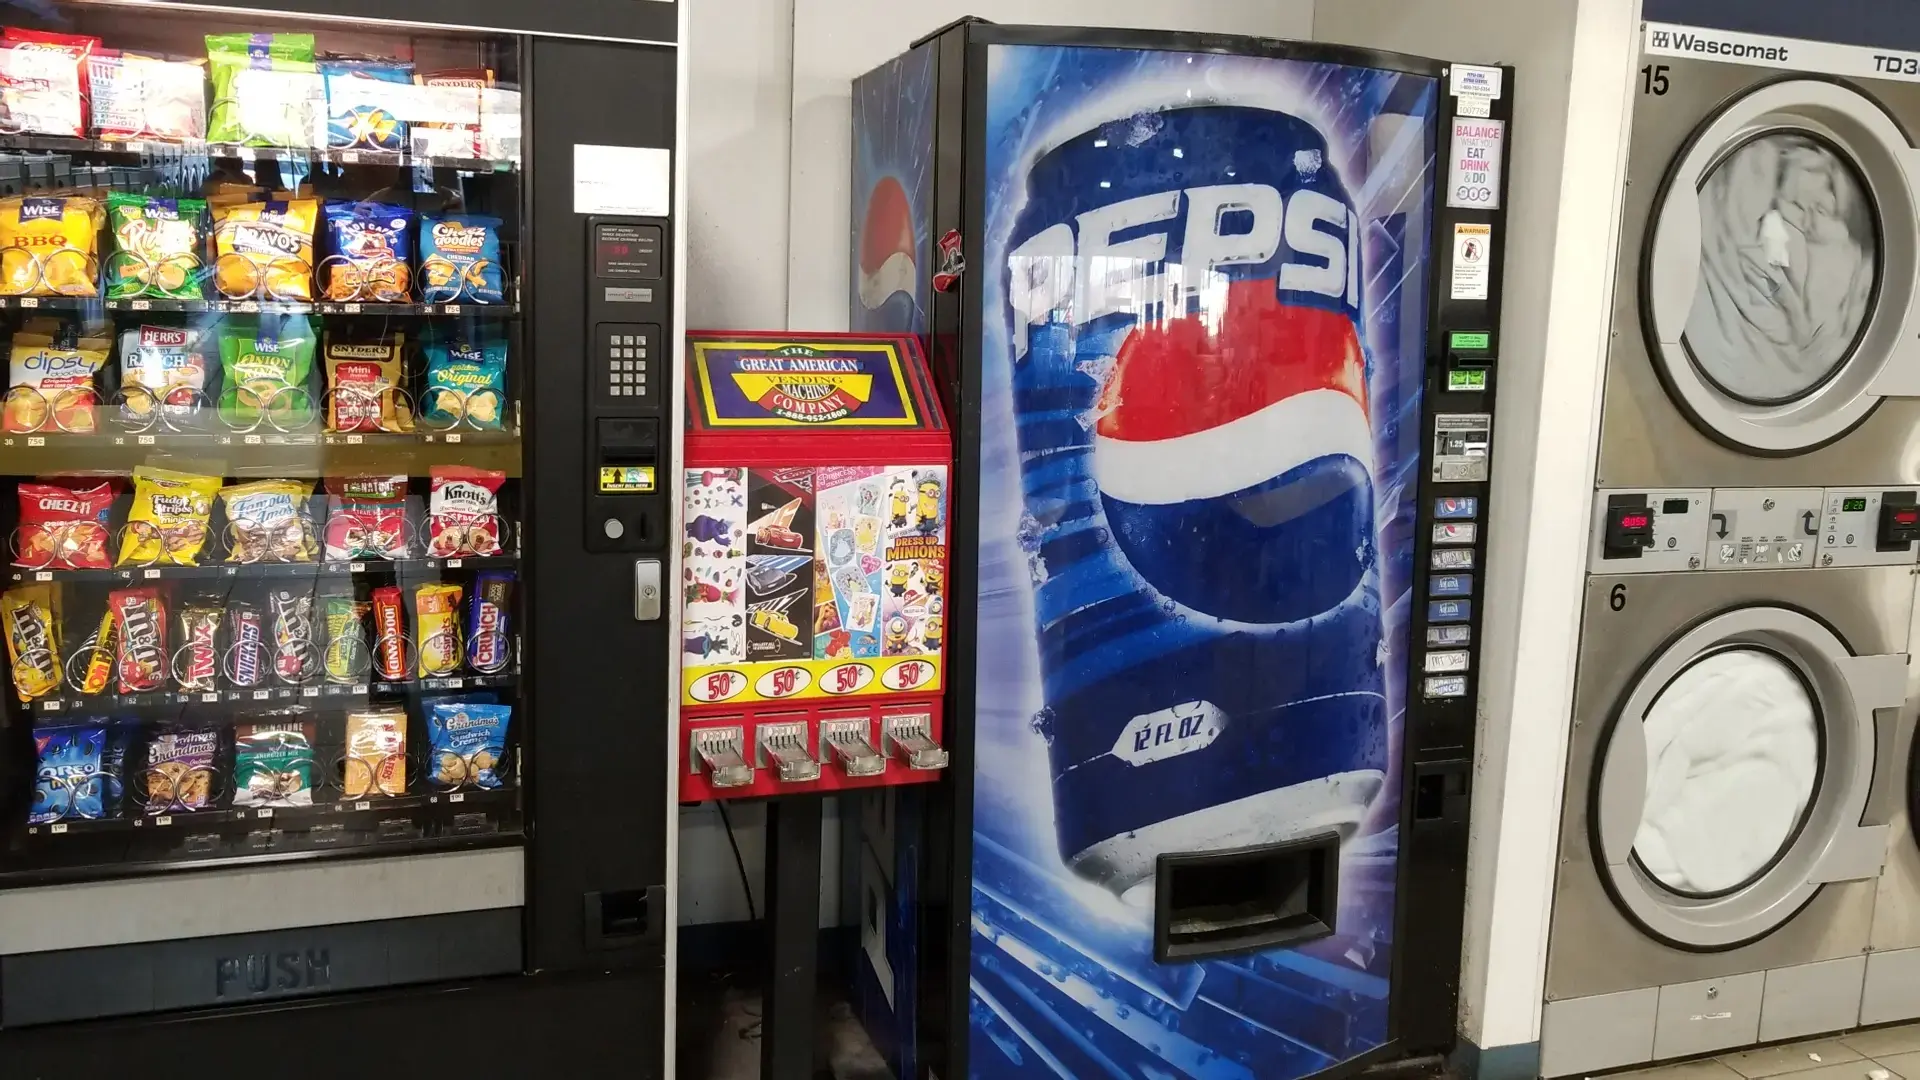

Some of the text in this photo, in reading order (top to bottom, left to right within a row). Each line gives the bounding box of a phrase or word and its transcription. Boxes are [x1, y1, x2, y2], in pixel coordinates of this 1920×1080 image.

[1672, 32, 1920, 74] Wascomat TD3
[1641, 63, 1670, 96] 15
[1456, 125, 1500, 139] BALANCE
[1461, 138, 1492, 147] WHAT YOU
[1467, 148, 1485, 158] EAT
[1460, 160, 1490, 171] DRINK
[1464, 172, 1486, 184] & DO
[23, 205, 59, 217] WISE
[145, 208, 179, 219] WISE
[432, 223, 486, 237] Cheez
[14, 235, 68, 248] BBQ
[434, 234, 485, 248] doodles
[1009, 183, 1360, 364] PEPSI
[22, 299, 37, 307] 75¢
[144, 330, 182, 343] HERR'S
[253, 342, 280, 353] WISE
[334, 344, 388, 354] SNYDER'S
[780, 346, 814, 357] THE
[240, 353, 292, 369] ONION
[450, 349, 483, 361] WISE
[25, 350, 95, 375] dipsy
[740, 358, 858, 372] GREAT AMERICAN
[347, 366, 371, 374] Mini
[437, 370, 492, 386] Original
[766, 376, 844, 384] VENDING
[782, 384, 831, 400] MACHINE
[772, 394, 846, 414] COMPANY
[776, 408, 848, 422] 1-888-952-1800
[28, 438, 44, 446] 75¢
[115, 437, 124, 445] 32
[222, 436, 231, 444] 34
[1450, 440, 1463, 448] 1.25
[152, 494, 190, 507] Fudge
[444, 485, 487, 505] Knott's
[39, 499, 91, 514] CHEEZ-IT
[152, 503, 194, 515] Stripes
[895, 535, 939, 547] DRESS UP
[885, 546, 946, 561] MINIONS
[1609, 583, 1627, 612] 6
[478, 602, 498, 665] CRUNCH
[188, 624, 216, 682] TWIX
[238, 619, 260, 686] SNICKERS
[1432, 656, 1444, 667] MT
[836, 665, 864, 692] 50¢
[898, 662, 925, 688] 50¢
[708, 673, 737, 700] 50¢
[773, 669, 801, 696] 50¢
[446, 717, 500, 732] Grandma's
[449, 731, 491, 742] Sandwich
[1134, 728, 1151, 753] 12
[1155, 722, 1174, 746] FL
[149, 742, 216, 765] Grandma's
[38, 765, 95, 778] OREO
[134, 819, 143, 827] 62
[29, 827, 37, 835] 60
[216, 948, 331, 997] PUSH
